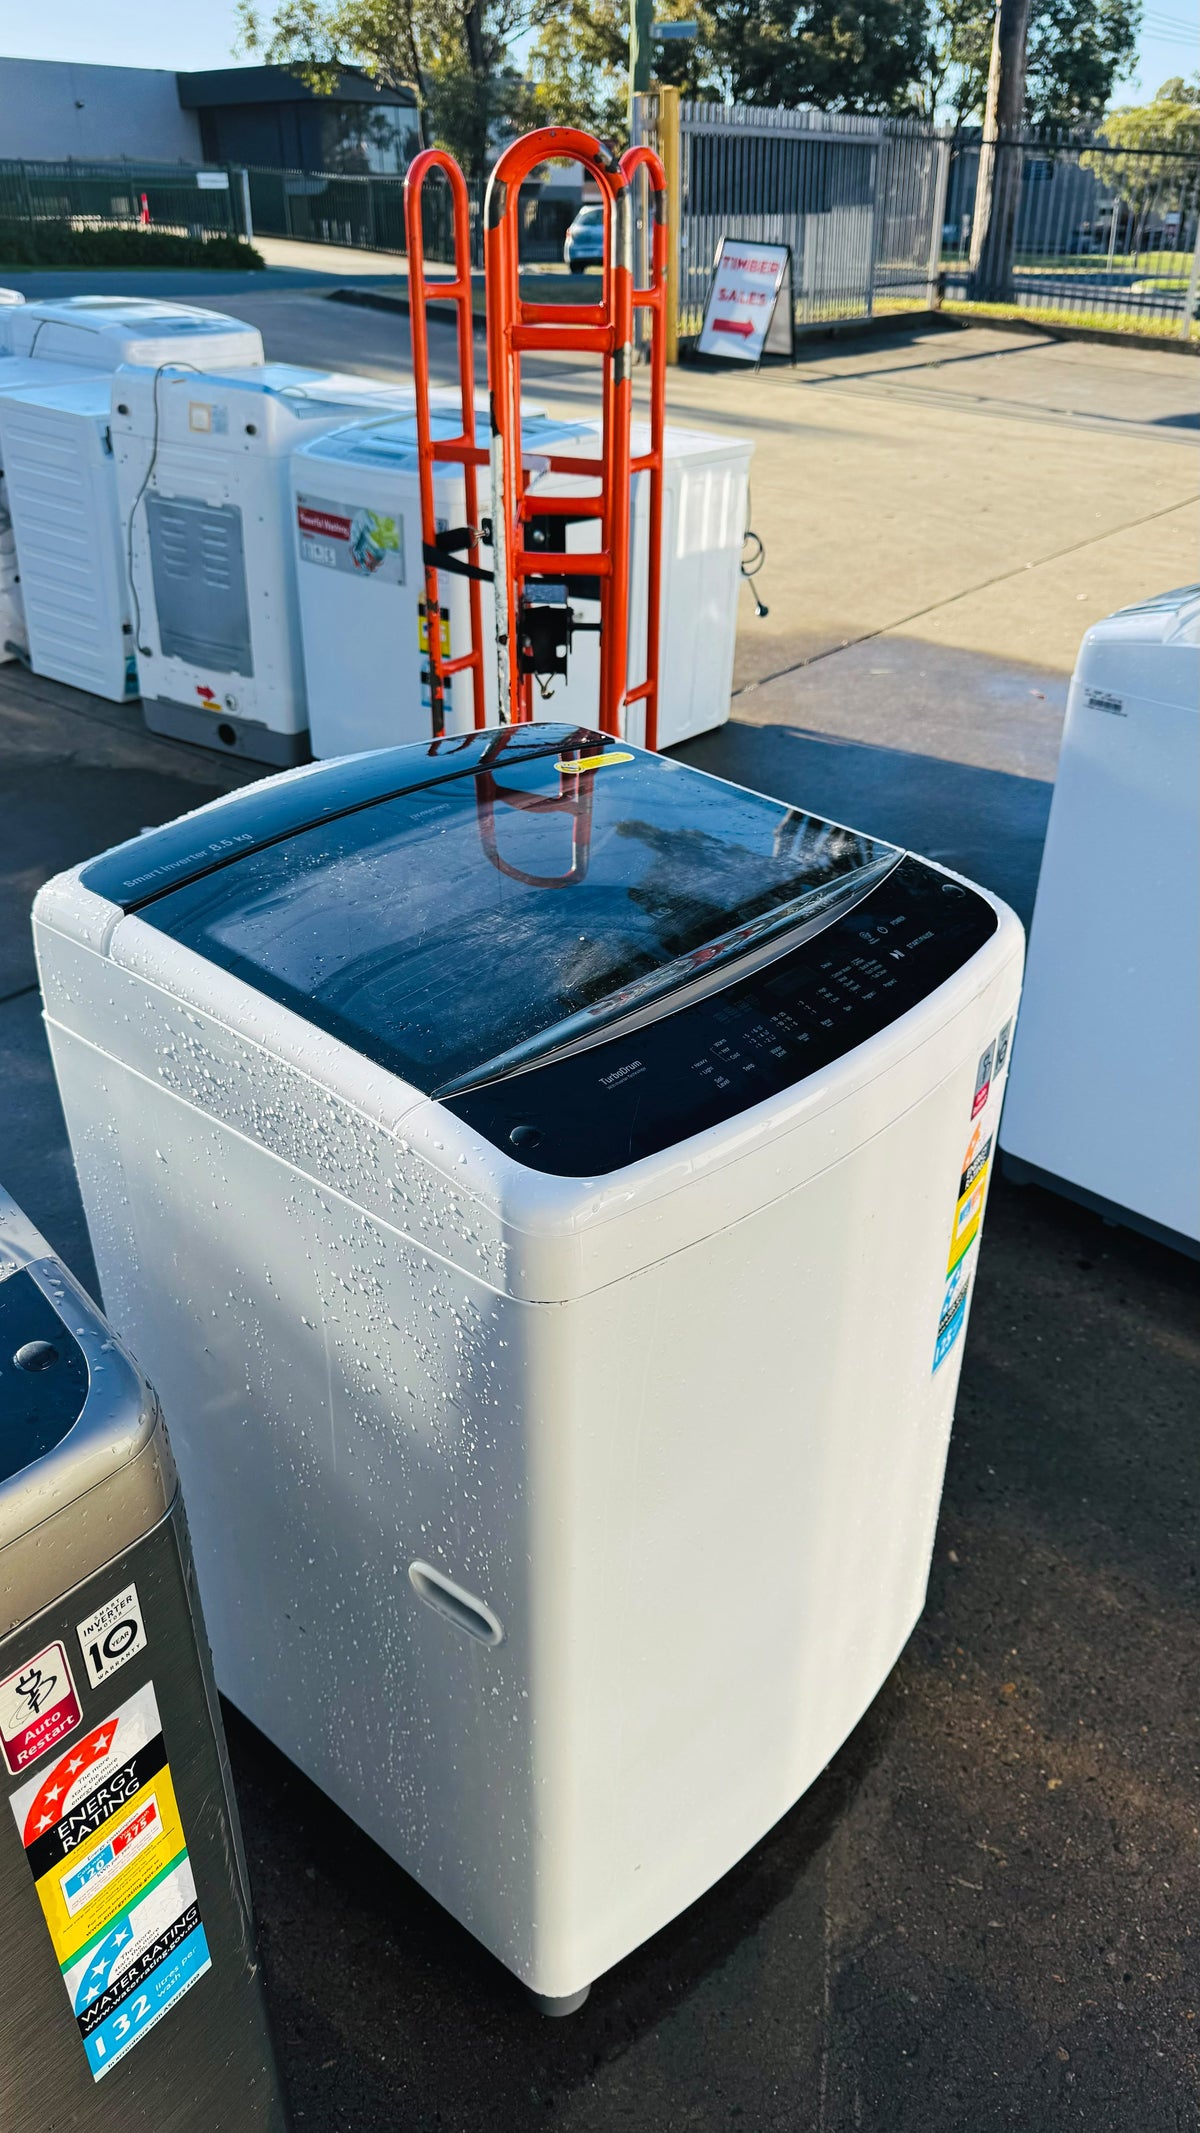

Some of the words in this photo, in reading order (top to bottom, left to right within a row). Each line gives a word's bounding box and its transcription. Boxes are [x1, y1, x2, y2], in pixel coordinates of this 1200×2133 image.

[722, 255, 779, 274] TIMBER
[718, 288, 767, 306] SALES
[123, 869, 163, 888] Smart
[160, 849, 208, 872] Inverter
[208, 839, 234, 852] 8.5
[233, 833, 253, 844] kg
[598, 1060, 643, 1085] TurboDrum
[83, 1595, 133, 1637] INVERTER
[94, 1599, 121, 1620] SMART
[98, 1611, 123, 1633] MOTOR
[89, 1619, 138, 1673] 10
[111, 1630, 130, 1647] YEAR
[97, 1643, 141, 1680] WARRANTY
[17, 1714, 75, 1765] Restart
[24, 1711, 61, 1745] Auto
[88, 1772, 100, 1784] the
[91, 1757, 110, 1772] more
[57, 1760, 137, 1840] ENERGY
[62, 1777, 140, 1853] RATING
[124, 1817, 148, 1844] 275
[80, 1859, 105, 1886] 120
[81, 1967, 139, 2023] WATER
[141, 1906, 197, 1967] RATING
[85, 1917, 198, 2031] www.waterrating.gov.au
[155, 1965, 180, 1992] litres
[181, 1946, 197, 1967] per
[157, 1973, 181, 1998] wash
